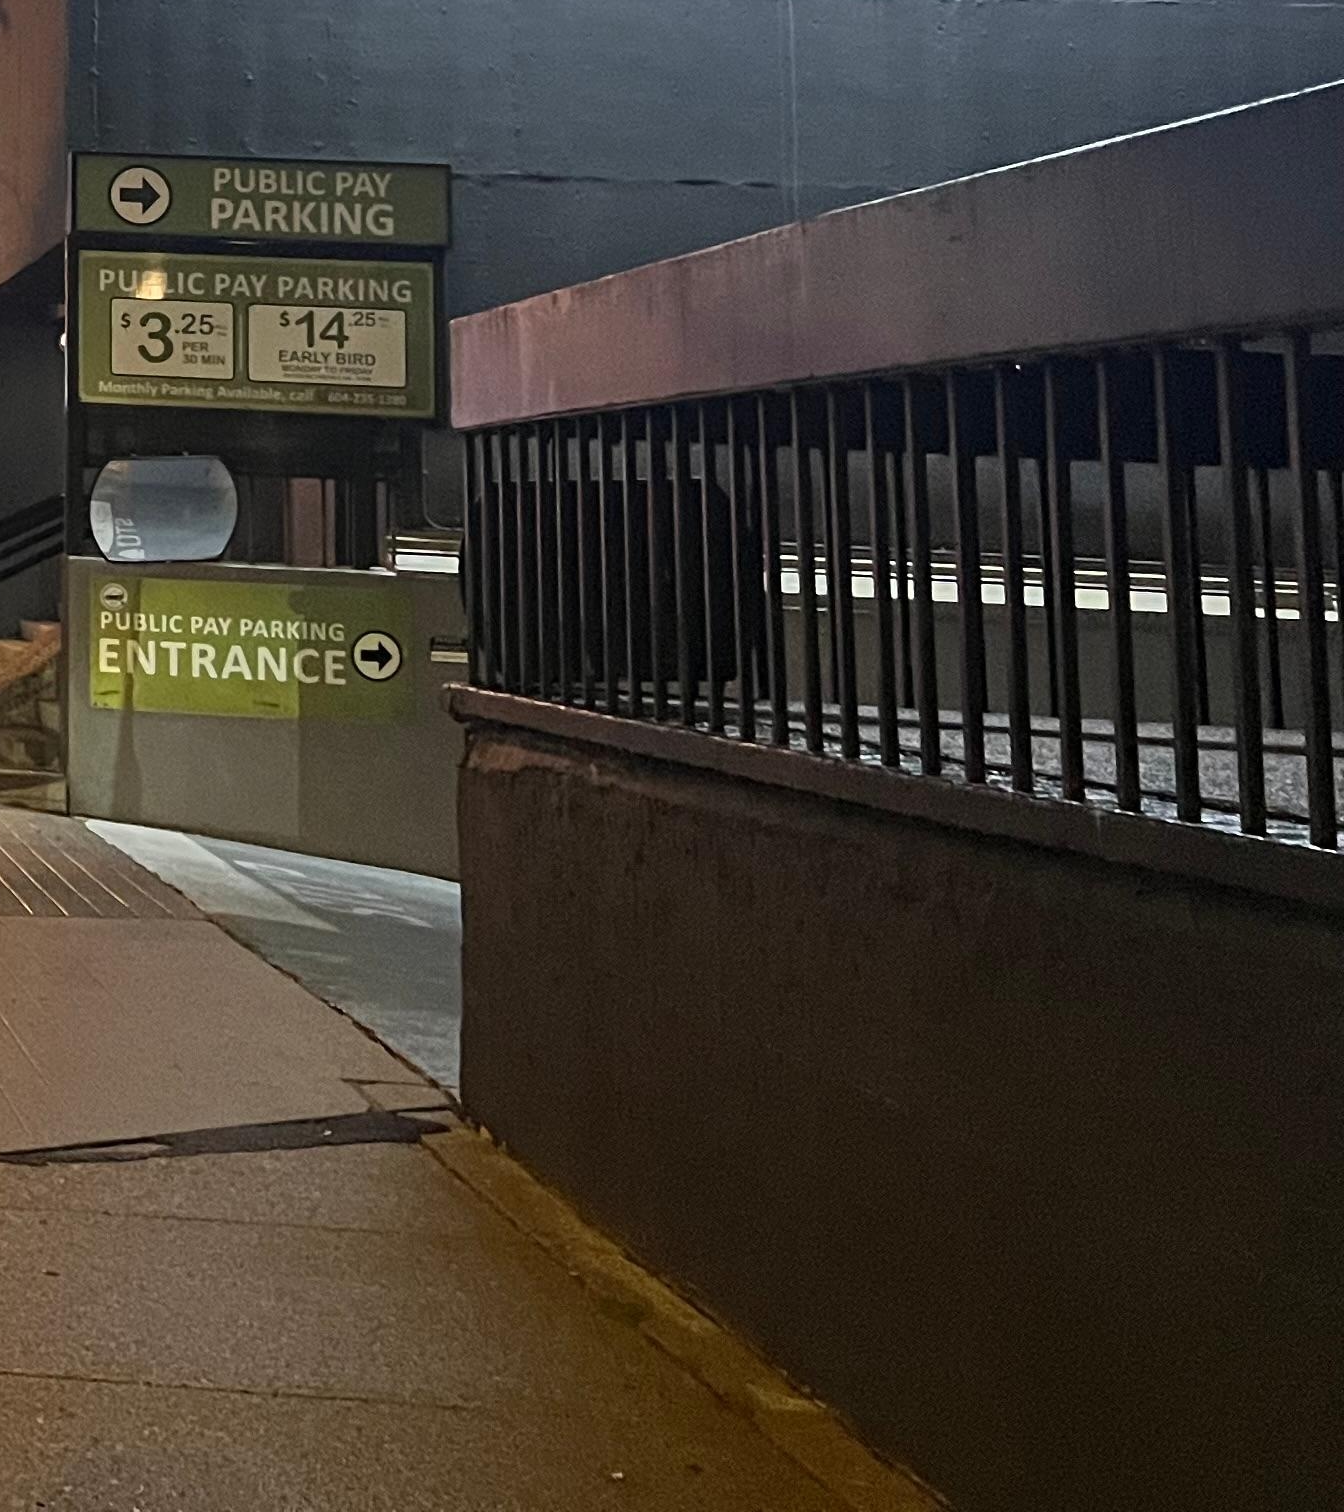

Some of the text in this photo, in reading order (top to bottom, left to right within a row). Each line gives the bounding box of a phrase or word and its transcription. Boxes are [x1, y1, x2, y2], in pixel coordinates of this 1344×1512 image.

[214, 167, 393, 198] PUBLIC PAY
[211, 197, 395, 236] PARKING
[98, 268, 412, 303] PULIC PAY PARKING
[182, 341, 209, 353] PER
[182, 354, 226, 366] 30 MIN
[278, 349, 377, 367] EARLY BIRD
[98, 380, 159, 397] Monthly
[161, 382, 214, 399] Parking
[100, 611, 346, 642] PUBLIC PAY PARKING
[98, 637, 348, 686] ENTRANCE
